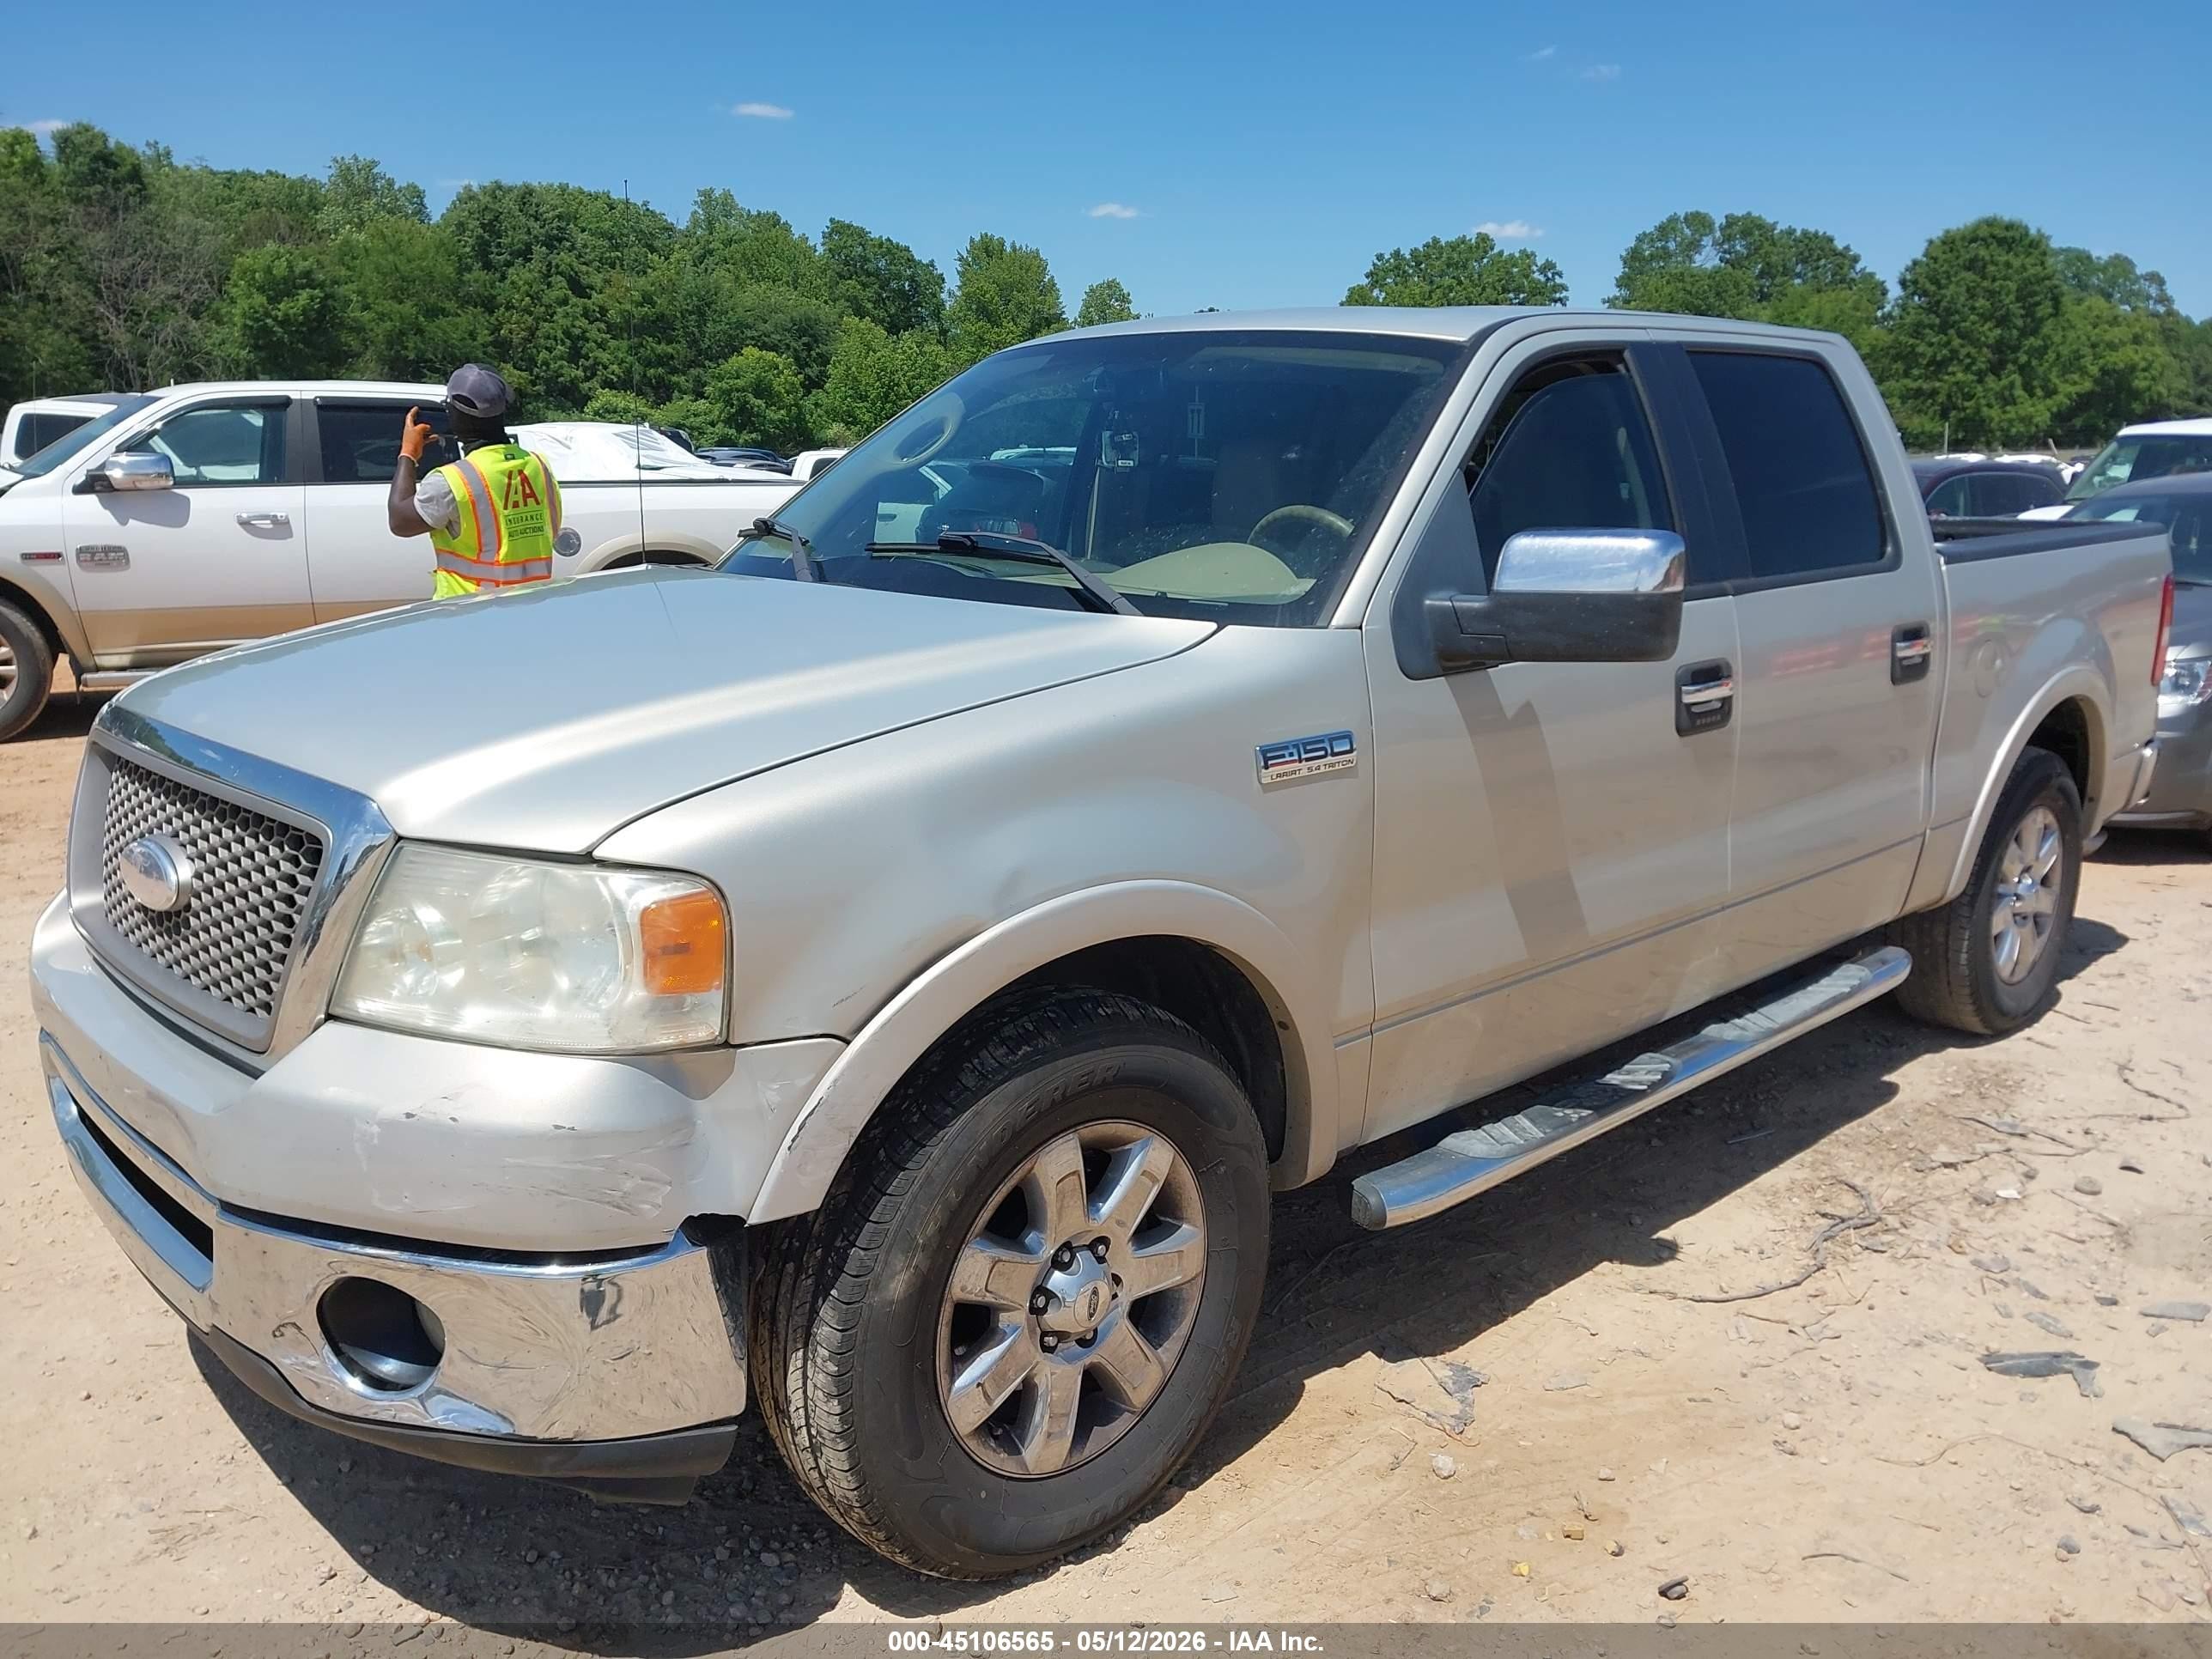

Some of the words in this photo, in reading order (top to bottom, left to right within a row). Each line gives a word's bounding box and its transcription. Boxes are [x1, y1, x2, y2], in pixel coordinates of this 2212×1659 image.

[503, 469, 540, 510] IAA
[506, 513, 543, 526] INSURANCE
[1322, 758, 1354, 771] TRITON
